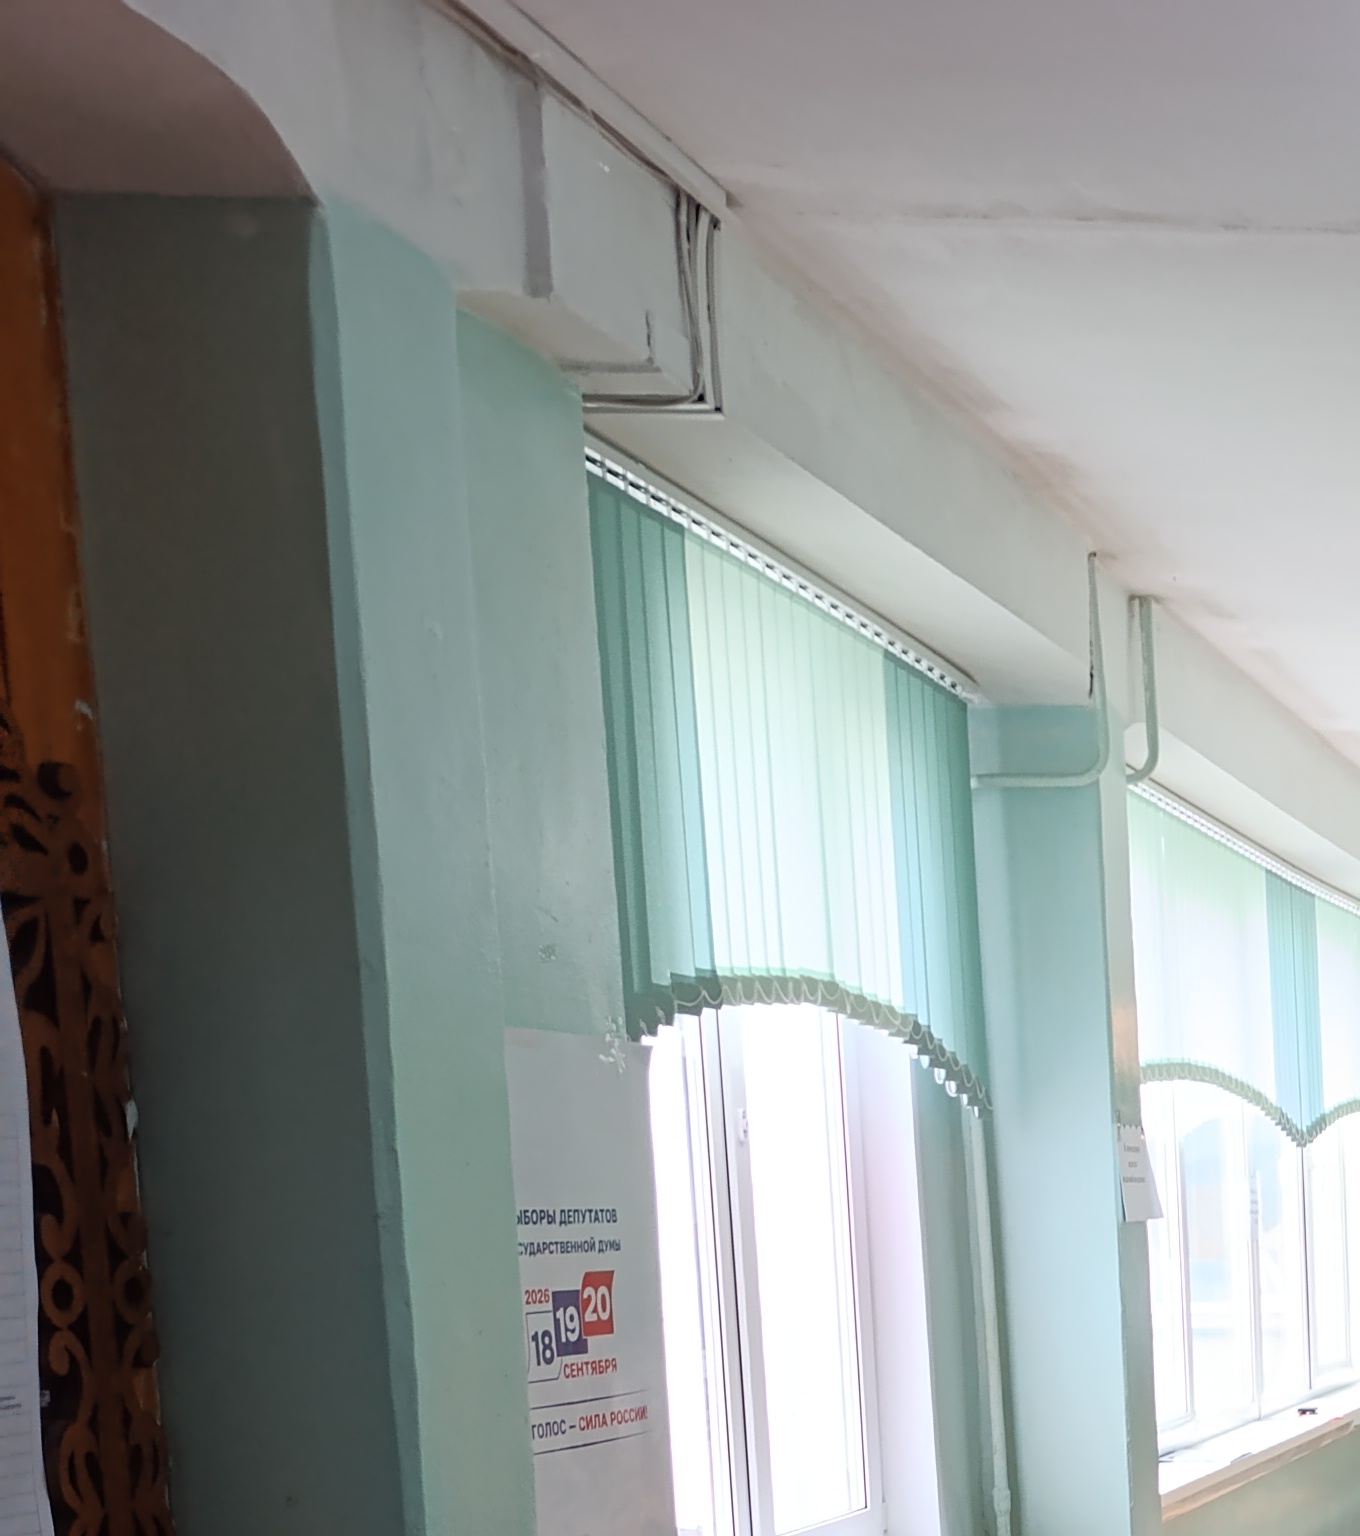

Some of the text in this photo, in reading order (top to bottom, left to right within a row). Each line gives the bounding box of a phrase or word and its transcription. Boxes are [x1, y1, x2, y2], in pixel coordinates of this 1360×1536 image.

[517, 1208, 618, 1226] ЫБОРЫ ДЕПУТАТОВ
[518, 1236, 622, 1257] СУДАРСТВЕННОЙ ДУМЫ
[525, 1288, 550, 1305] 2026
[531, 1285, 611, 1366] 18 19 20
[563, 1358, 618, 1379] СЕНТЯБРЯ
[532, 1420, 566, 1440] ГОЛОС
[578, 1413, 608, 1432] СИЛА
[610, 1405, 648, 1426] РОССИИ!
